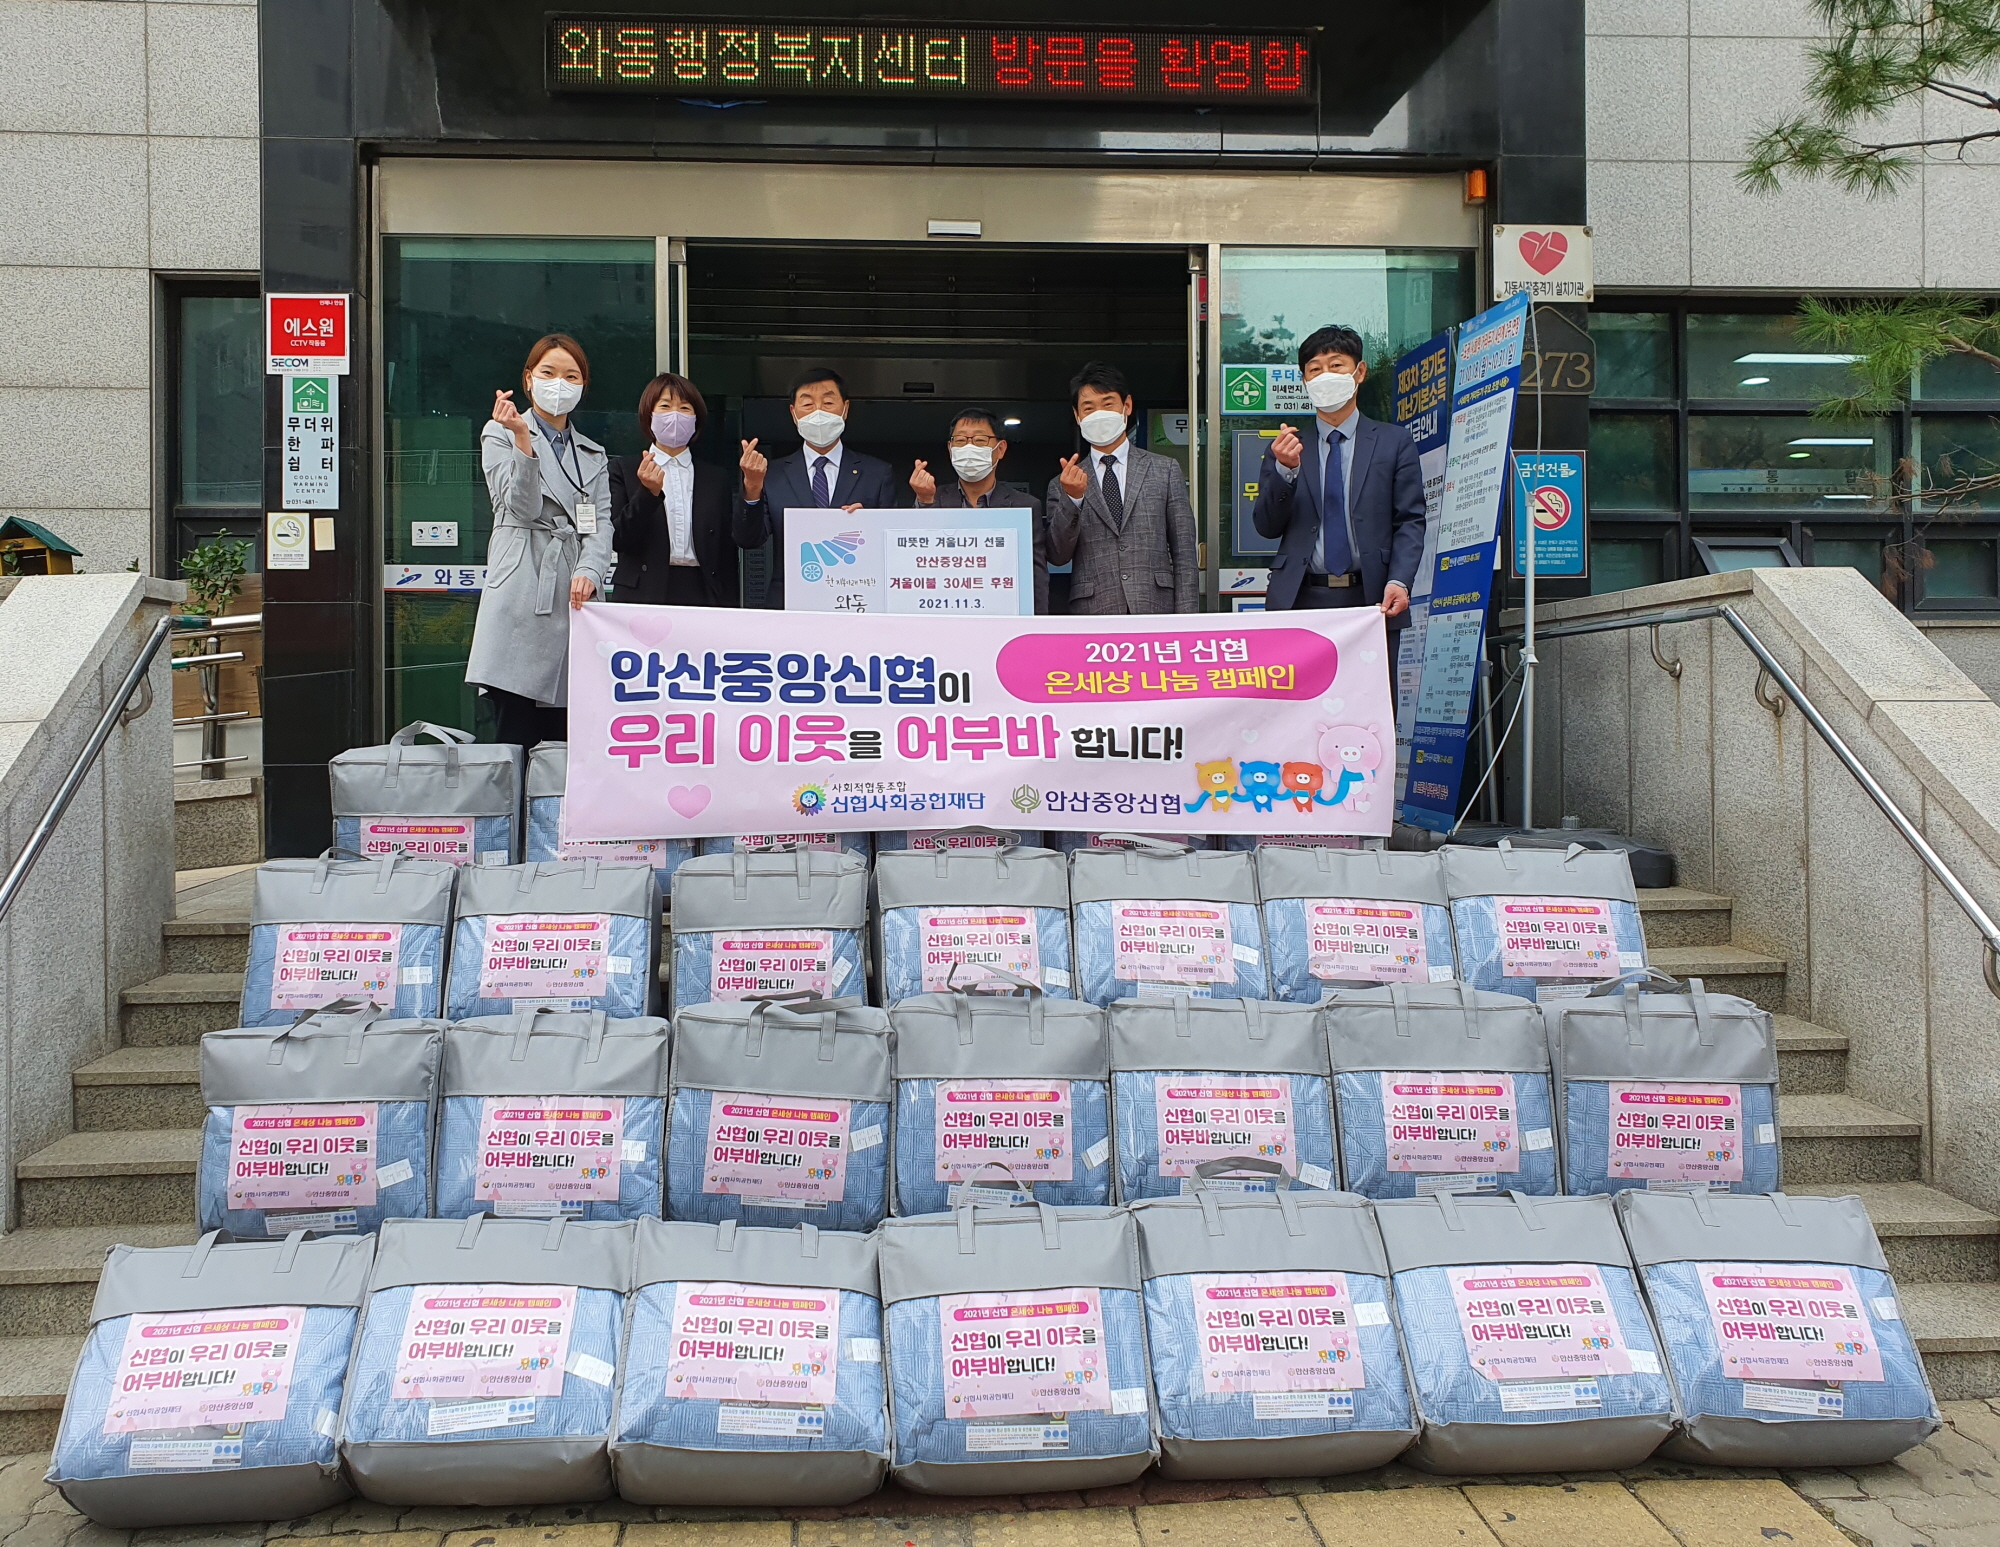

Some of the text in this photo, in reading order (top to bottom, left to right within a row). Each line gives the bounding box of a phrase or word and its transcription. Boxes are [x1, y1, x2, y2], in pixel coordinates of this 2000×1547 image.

[560, 28, 1308, 91] 와동행정복지센터 방문을 환영합
[1504, 281, 1584, 296] 자동심충격기 설치기관
[284, 318, 334, 337] 에스원
[271, 358, 308, 367] SECOM
[1398, 348, 1446, 394] 제3차 경기도
[1520, 351, 1591, 388] 273
[1272, 385, 1303, 394] 미세먼지
[1284, 403, 1299, 411] 031)
[1397, 376, 1447, 422] 재난기본소득
[1520, 463, 1571, 478] 금연건물
[897, 537, 1005, 548] 따뜻한 겨울나기 선물
[916, 556, 987, 568] 안산중앙신협
[889, 577, 1014, 590] 겨울이불 30세트 후원
[834, 594, 868, 613] 와동
[919, 599, 985, 609] 2021.11.3.
[1085, 638, 1248, 664] 2021년 신협
[611, 651, 970, 704] 안산중앙신협이
[1045, 664, 1295, 695] 온세상 나눔 캠페인
[608, 712, 1183, 768] 우리 이웃을 어부바 합니다!
[832, 781, 906, 793] 사회적협동조합
[831, 792, 986, 813] 신협사회공헌재단
[1045, 791, 1181, 815] 안산중앙신협
[366, 841, 467, 853] 신협이 우리 이웃을
[948, 836, 972, 848] 우리
[926, 932, 1030, 946] 신협이 우리 이웃을
[1119, 924, 1224, 938] 신협이 우리 이웃을
[490, 938, 601, 952] 신협이 우리 이웃을
[718, 958, 826, 971] 신협이 우리 이웃을
[250, 1119, 274, 1128] 2021년
[293, 1118, 315, 1127] 온세상
[317, 1118, 332, 1126] 나눔
[335, 1117, 356, 1126] 캠페인
[943, 1111, 1063, 1127] 신협이 우리 이웃을
[1616, 1112, 1735, 1130] 신협이 우리 이웃을
[237, 1136, 368, 1155] 신협이 우리 이웃을
[487, 1130, 614, 1146] 신협이 우리 이웃을
[699, 1295, 816, 1309] 2021년 신협 온세상 나눔 캠페인
[1714, 1298, 1858, 1318] 신협이 우리 이웃을
[412, 1317, 562, 1335] 신협이 우리 이웃을
[1204, 1307, 1346, 1328] 신협이 우리 이웃을
[681, 1316, 828, 1339] 신협이 우리 이웃을
[950, 1325, 1096, 1351] 신협이 우리 이웃을
[128, 1339, 289, 1367] 신협이 우리 이웃을
